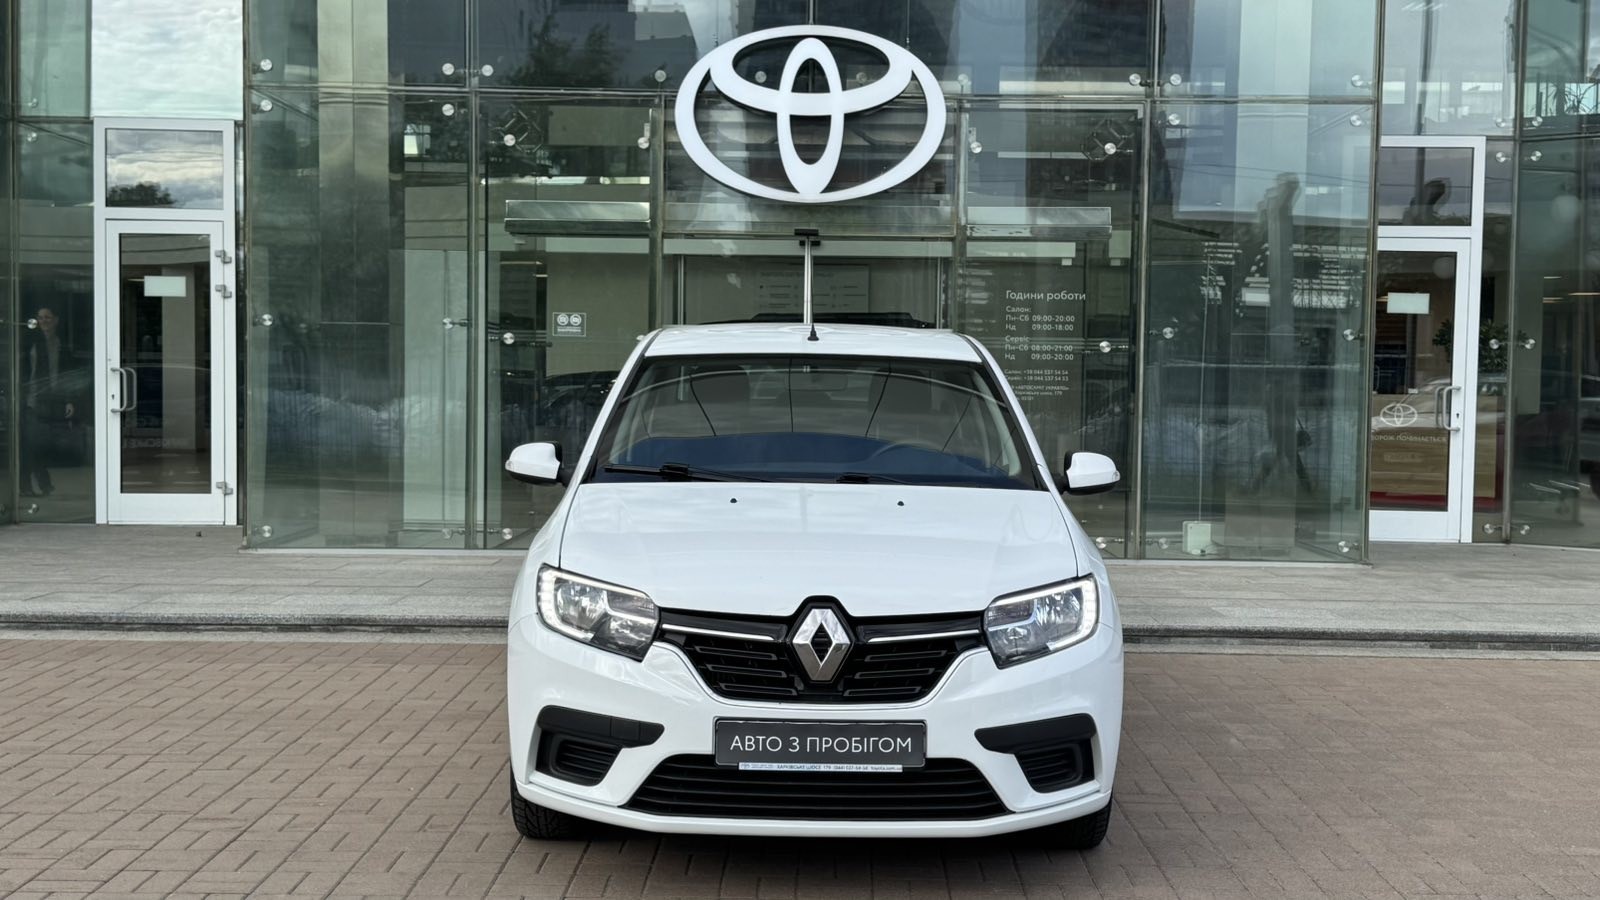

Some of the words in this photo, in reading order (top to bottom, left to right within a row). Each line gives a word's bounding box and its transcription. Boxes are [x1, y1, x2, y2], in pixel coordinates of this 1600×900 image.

[1006, 290, 1044, 301] Години
[1046, 290, 1086, 302] роботи
[1005, 305, 1031, 313] Салон:
[1005, 314, 1030, 322] Пн-Сб
[1032, 314, 1075, 322] 09:00-20:00
[1005, 323, 1016, 331] Нд
[1032, 323, 1074, 331] 09:00-18:00
[1004, 343, 1029, 351] Пн-Сб
[1031, 344, 1073, 352] 08:00-21:00
[1004, 352, 1016, 360] Нд
[1031, 353, 1074, 361] 09:00-20:00
[730, 735, 782, 752] АВТО
[788, 736, 800, 752] З
[806, 737, 912, 753] ПРОБІГОМ
